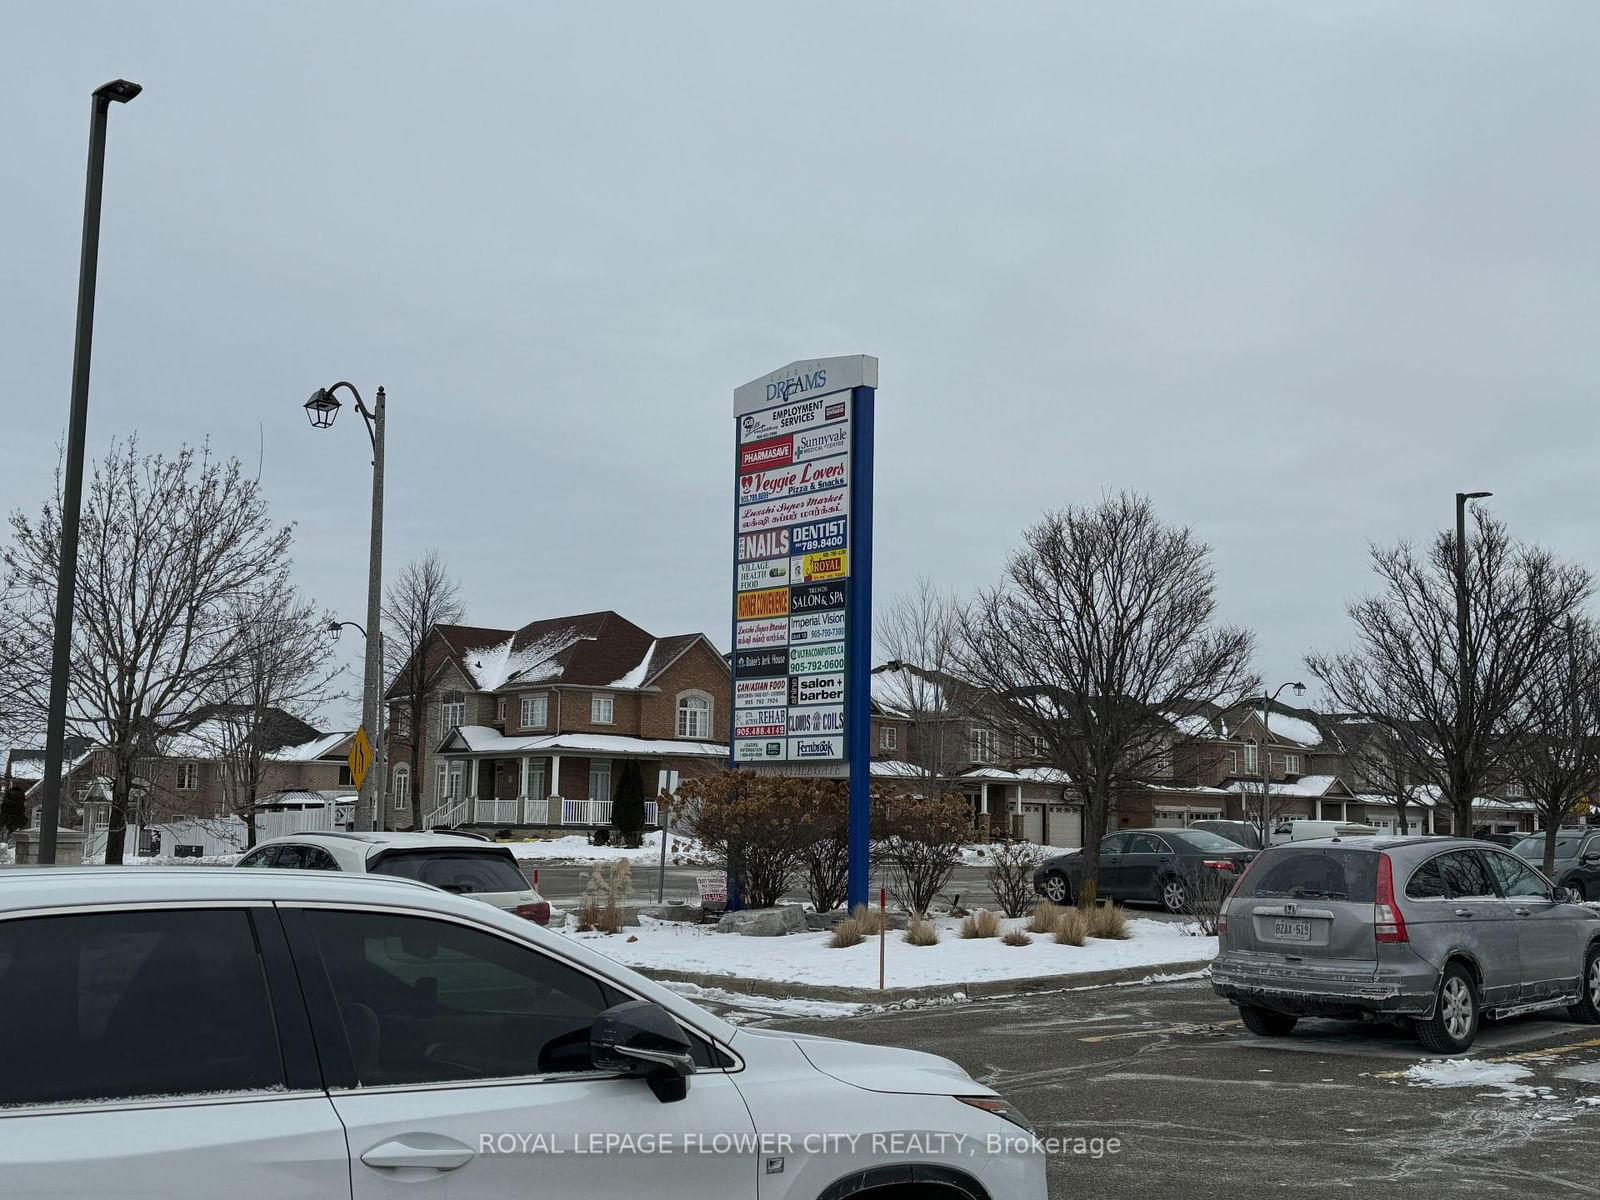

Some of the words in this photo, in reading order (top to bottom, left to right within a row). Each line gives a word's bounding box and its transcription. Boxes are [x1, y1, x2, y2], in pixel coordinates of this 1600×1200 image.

[766, 370, 827, 402] DREAMS
[772, 400, 824, 421] EMPLOYMENT
[780, 411, 815, 428] SERVICES
[801, 428, 847, 450] Sunnyvale
[744, 446, 790, 464] PHARMASAVE
[755, 472, 796, 494] Veggie
[800, 462, 844, 484] Lovers
[788, 485, 808, 495] Pizza
[810, 481, 816, 490] &
[818, 477, 844, 488] Snacks
[742, 506, 775, 519] Luxshi
[776, 500, 804, 515] Super
[806, 493, 843, 507] Market
[793, 520, 846, 542] DENTIST
[746, 529, 789, 560] NAILS
[802, 536, 843, 551] 789.8400
[741, 561, 770, 571] VILLAGE
[814, 559, 840, 572] ROYAL
[741, 570, 767, 581] HEALTH
[740, 580, 758, 589] FOOD
[757, 588, 788, 615] CONVENIENCE
[792, 595, 820, 610] SALON
[829, 591, 844, 605] SPA
[791, 614, 820, 629] Imperial
[822, 612, 845, 624] Vision
[771, 654, 786, 664] House
[790, 659, 844, 672] 905-792-0600
[737, 682, 768, 693] CAN/ASIAN
[769, 680, 785, 690] FOOD
[800, 678, 834, 689] salon
[800, 689, 843, 702] barber
[758, 710, 785, 725] REHAB
[789, 714, 811, 732] CLOUDS
[823, 712, 844, 730] COILS
[797, 740, 835, 757] Fernbrook
